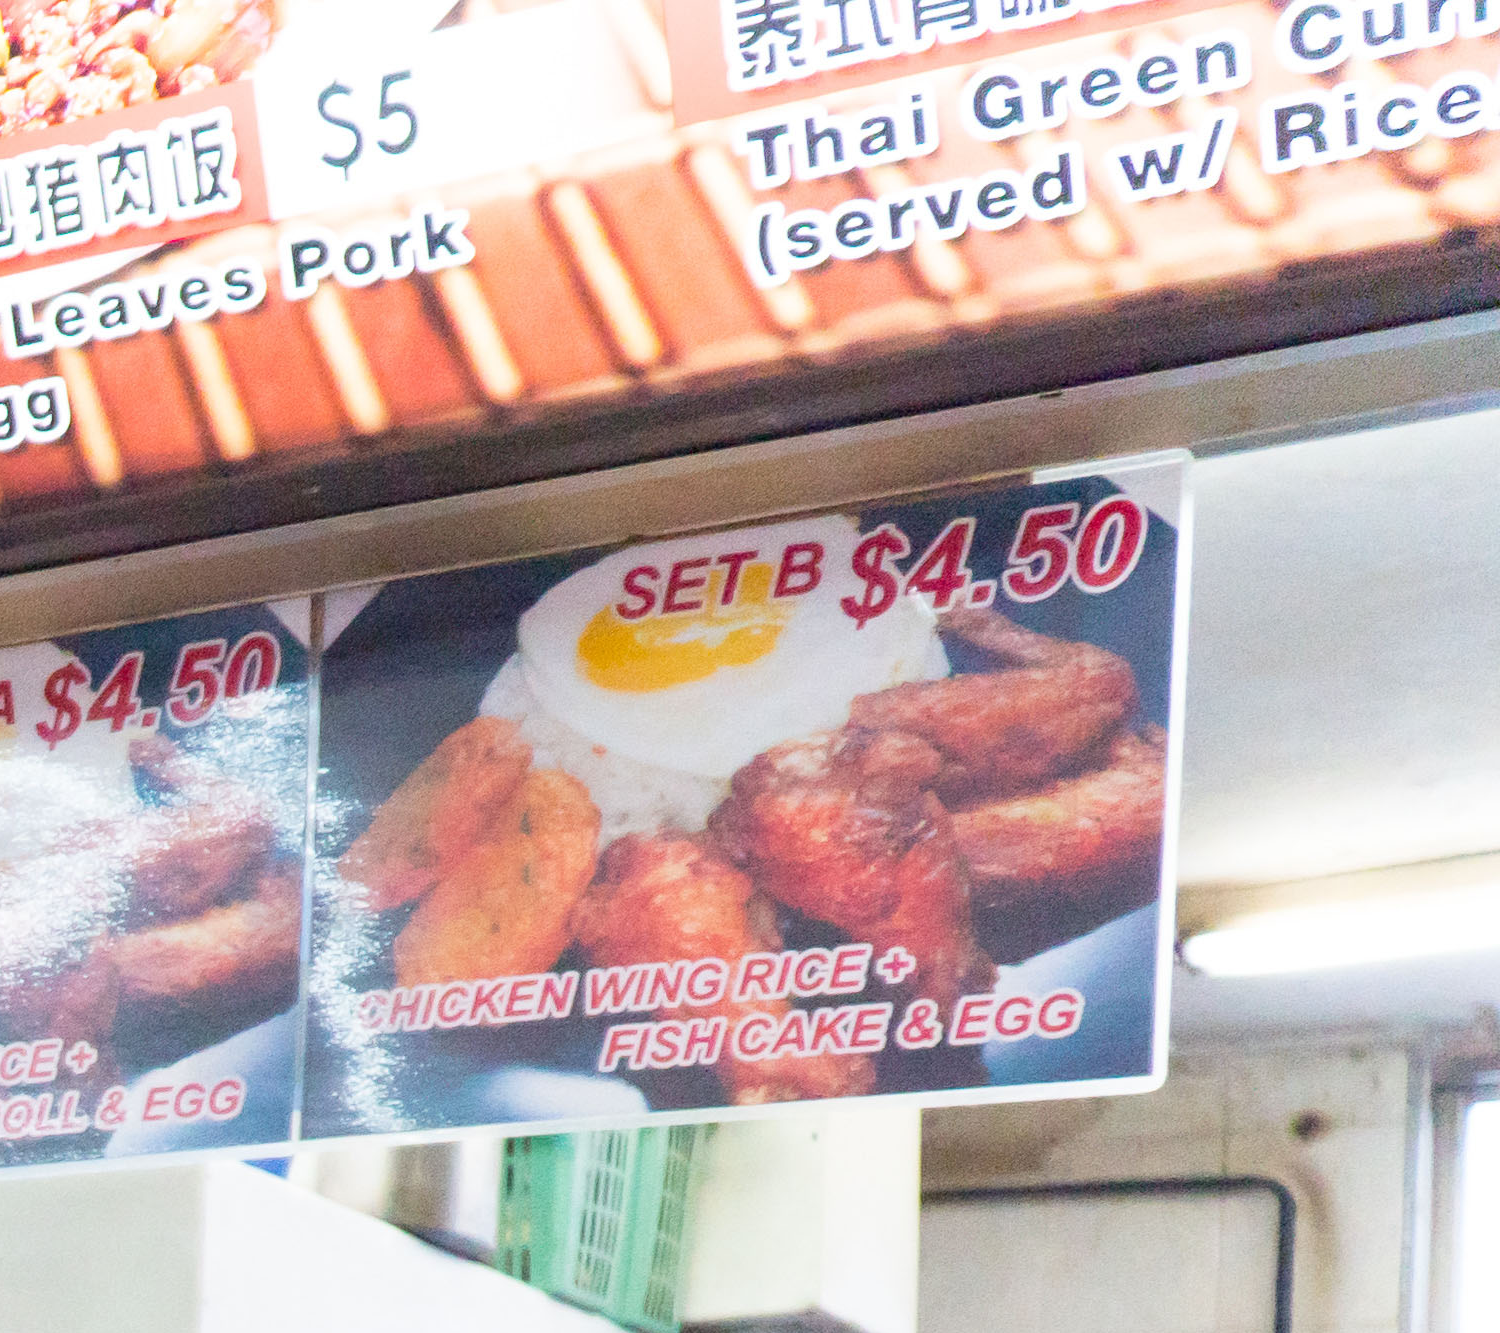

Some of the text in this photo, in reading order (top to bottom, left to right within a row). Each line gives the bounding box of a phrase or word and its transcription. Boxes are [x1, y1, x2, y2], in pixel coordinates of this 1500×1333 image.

[315, 68, 421, 183] $5
[747, 92, 926, 178] Thai
[972, 38, 1239, 130] Green
[756, 153, 1077, 277] (served
[1120, 120, 1225, 193] w/
[12, 264, 256, 349] Leaves
[290, 209, 466, 293] Pork
[615, 499, 1143, 629] SET B $4.50
[35, 634, 281, 750] $4.50
[358, 974, 577, 1029] CHICKEN
[583, 961, 724, 1014] WING
[738, 949, 869, 996] RICE
[600, 993, 1084, 1072] FISH CAKE & EGG
[96, 1095, 127, 1127] &
[142, 1082, 244, 1121] EGG
